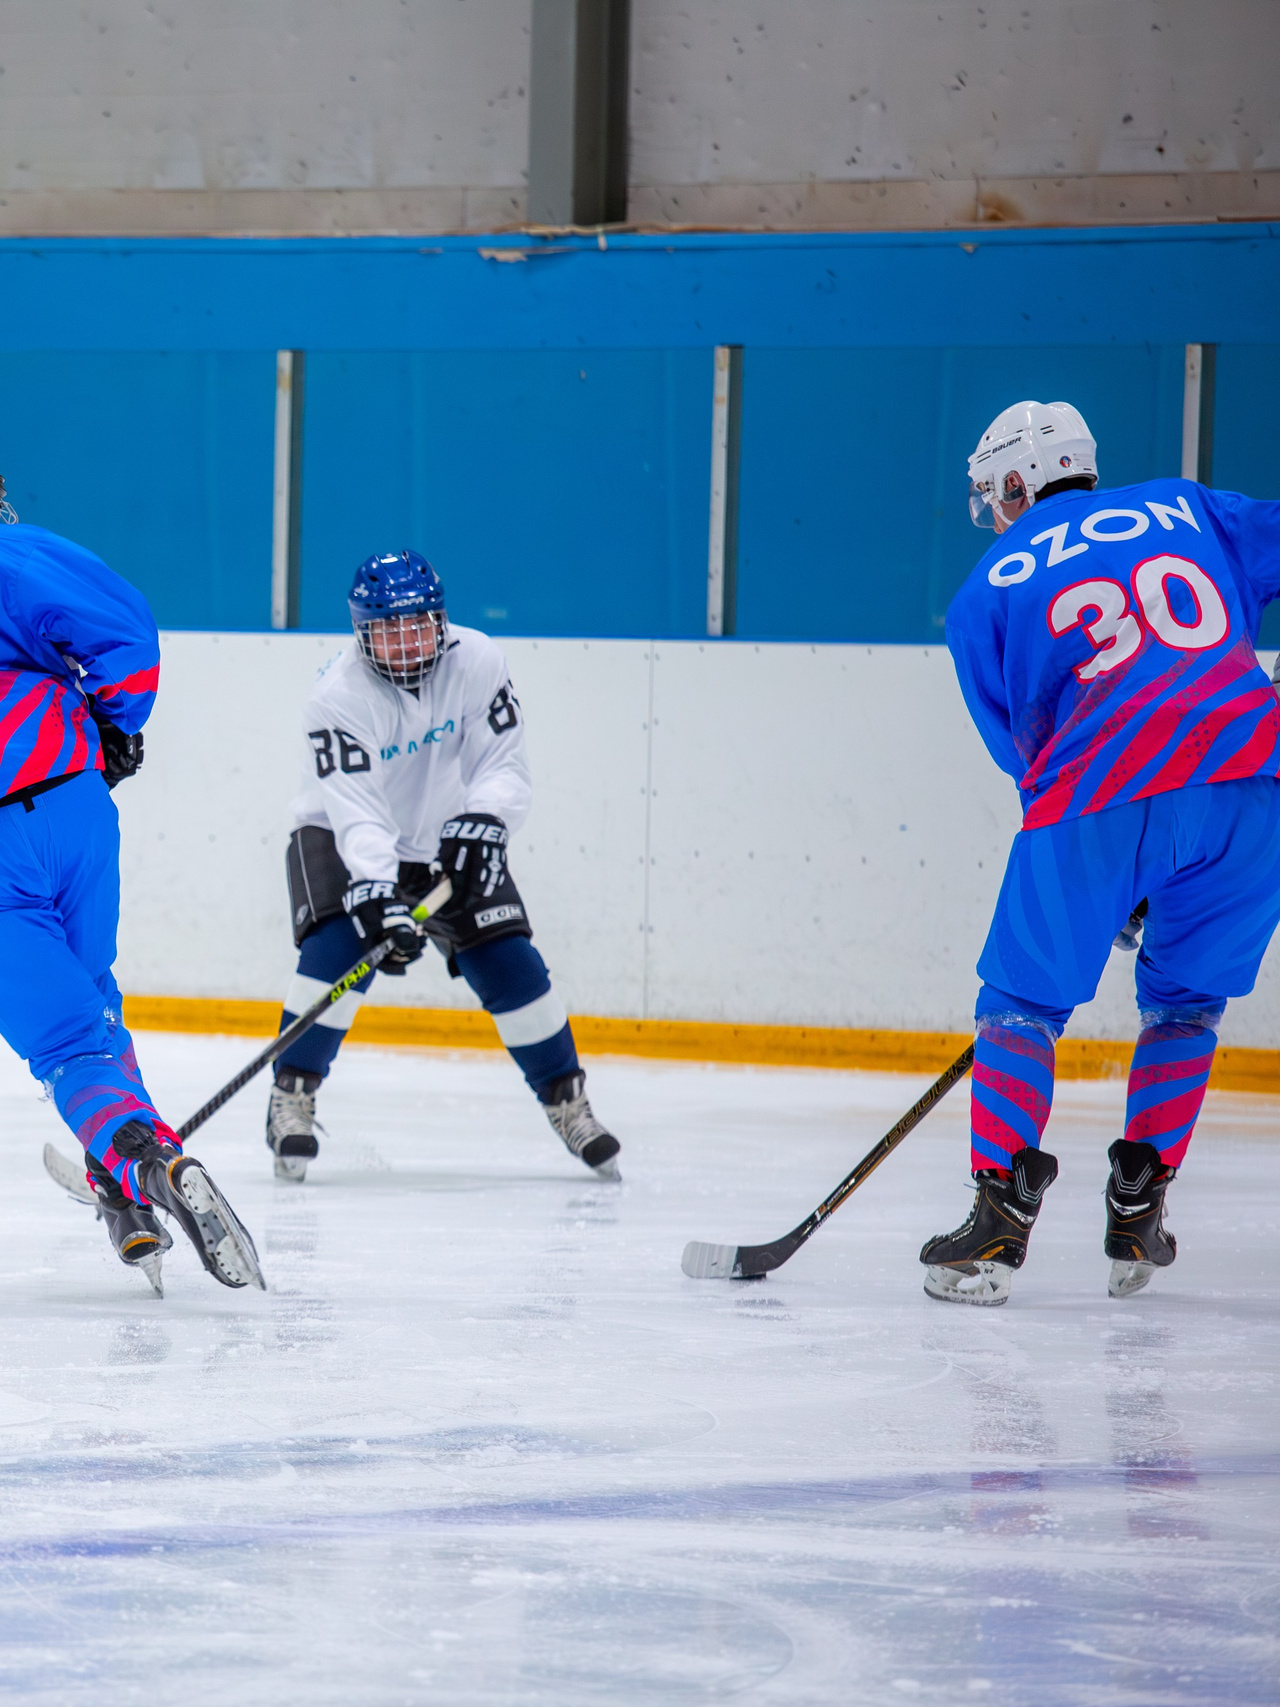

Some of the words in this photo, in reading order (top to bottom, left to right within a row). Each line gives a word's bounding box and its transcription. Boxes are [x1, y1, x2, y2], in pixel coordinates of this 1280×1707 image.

[991, 436, 1022, 454] BAUER
[988, 496, 1201, 587] OZON
[1046, 552, 1230, 684] 30
[441, 821, 508, 844] AUER
[342, 883, 395, 914] UER
[475, 904, 523, 928] CCM
[331, 962, 371, 1002] ALPHA
